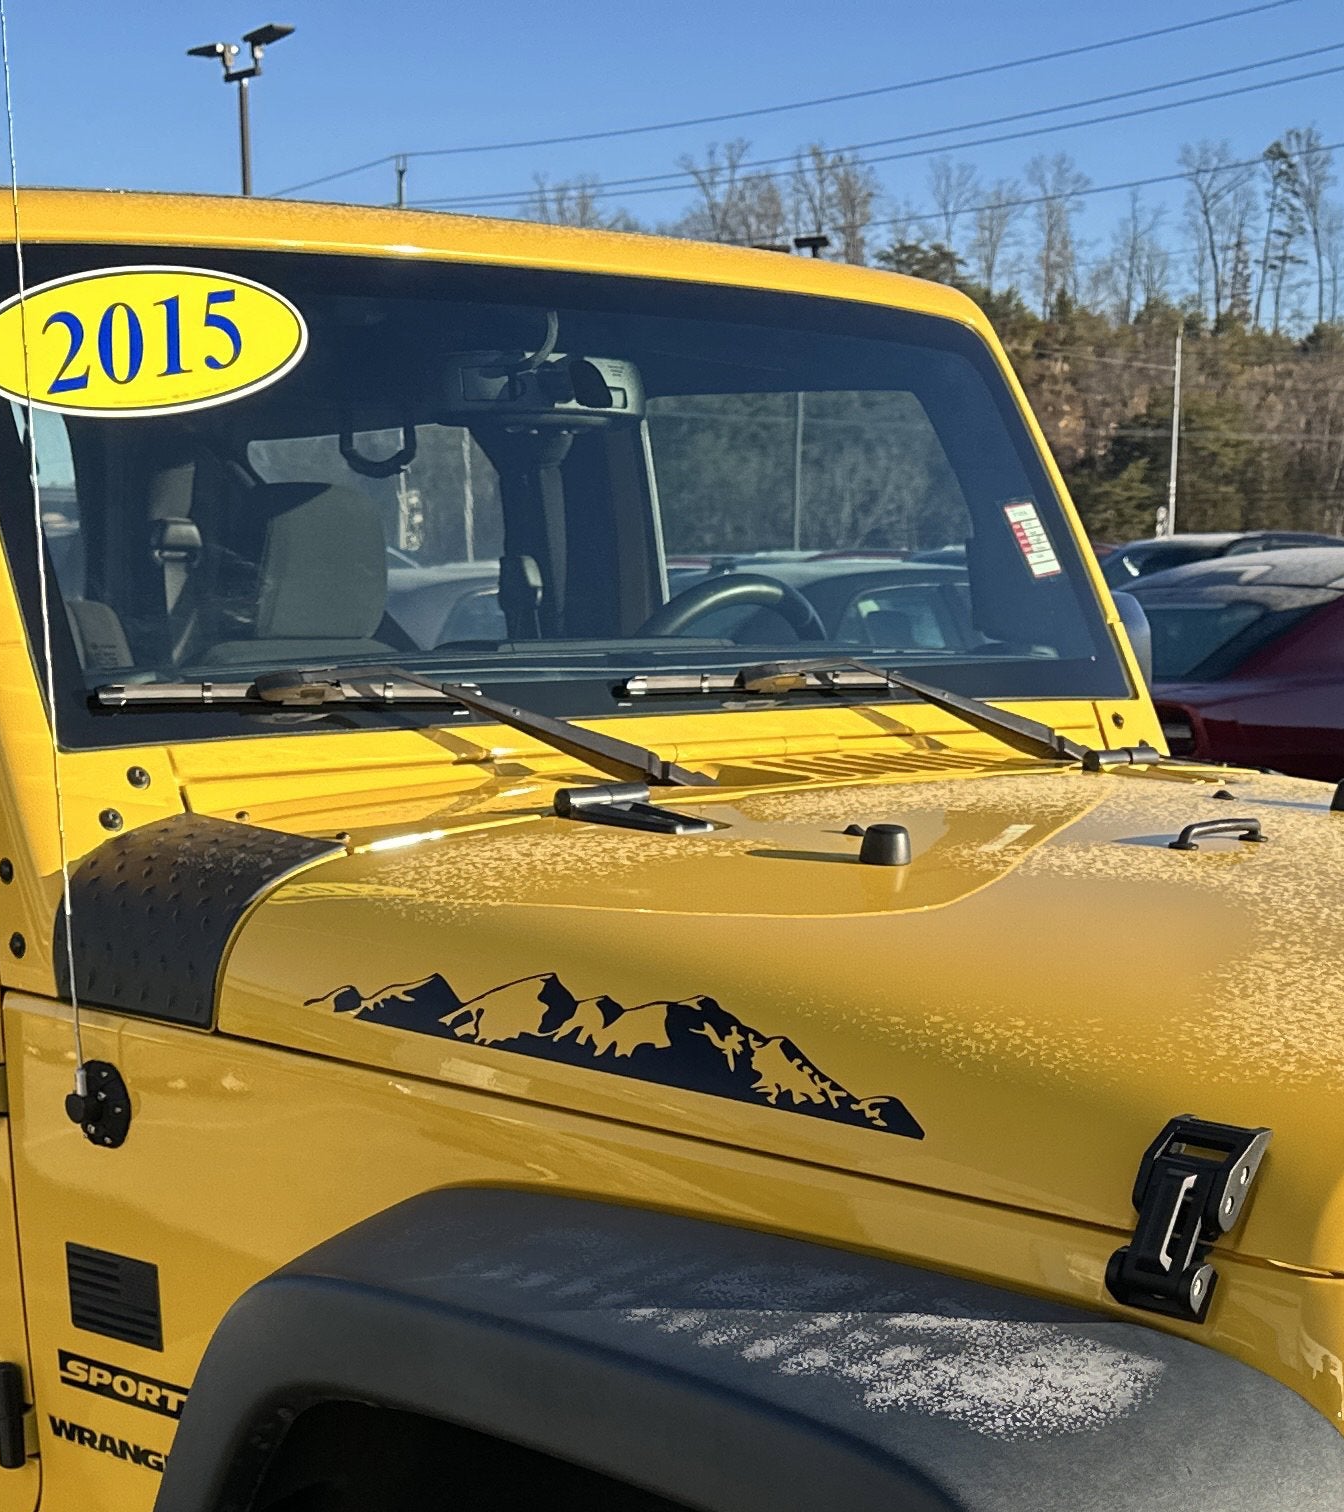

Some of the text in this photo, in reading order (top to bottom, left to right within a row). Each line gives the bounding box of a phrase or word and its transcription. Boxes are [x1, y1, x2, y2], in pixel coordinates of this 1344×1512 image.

[42, 289, 242, 394] 2015
[60, 1359, 189, 1413] SPORT
[48, 1414, 169, 1473] WRANG
